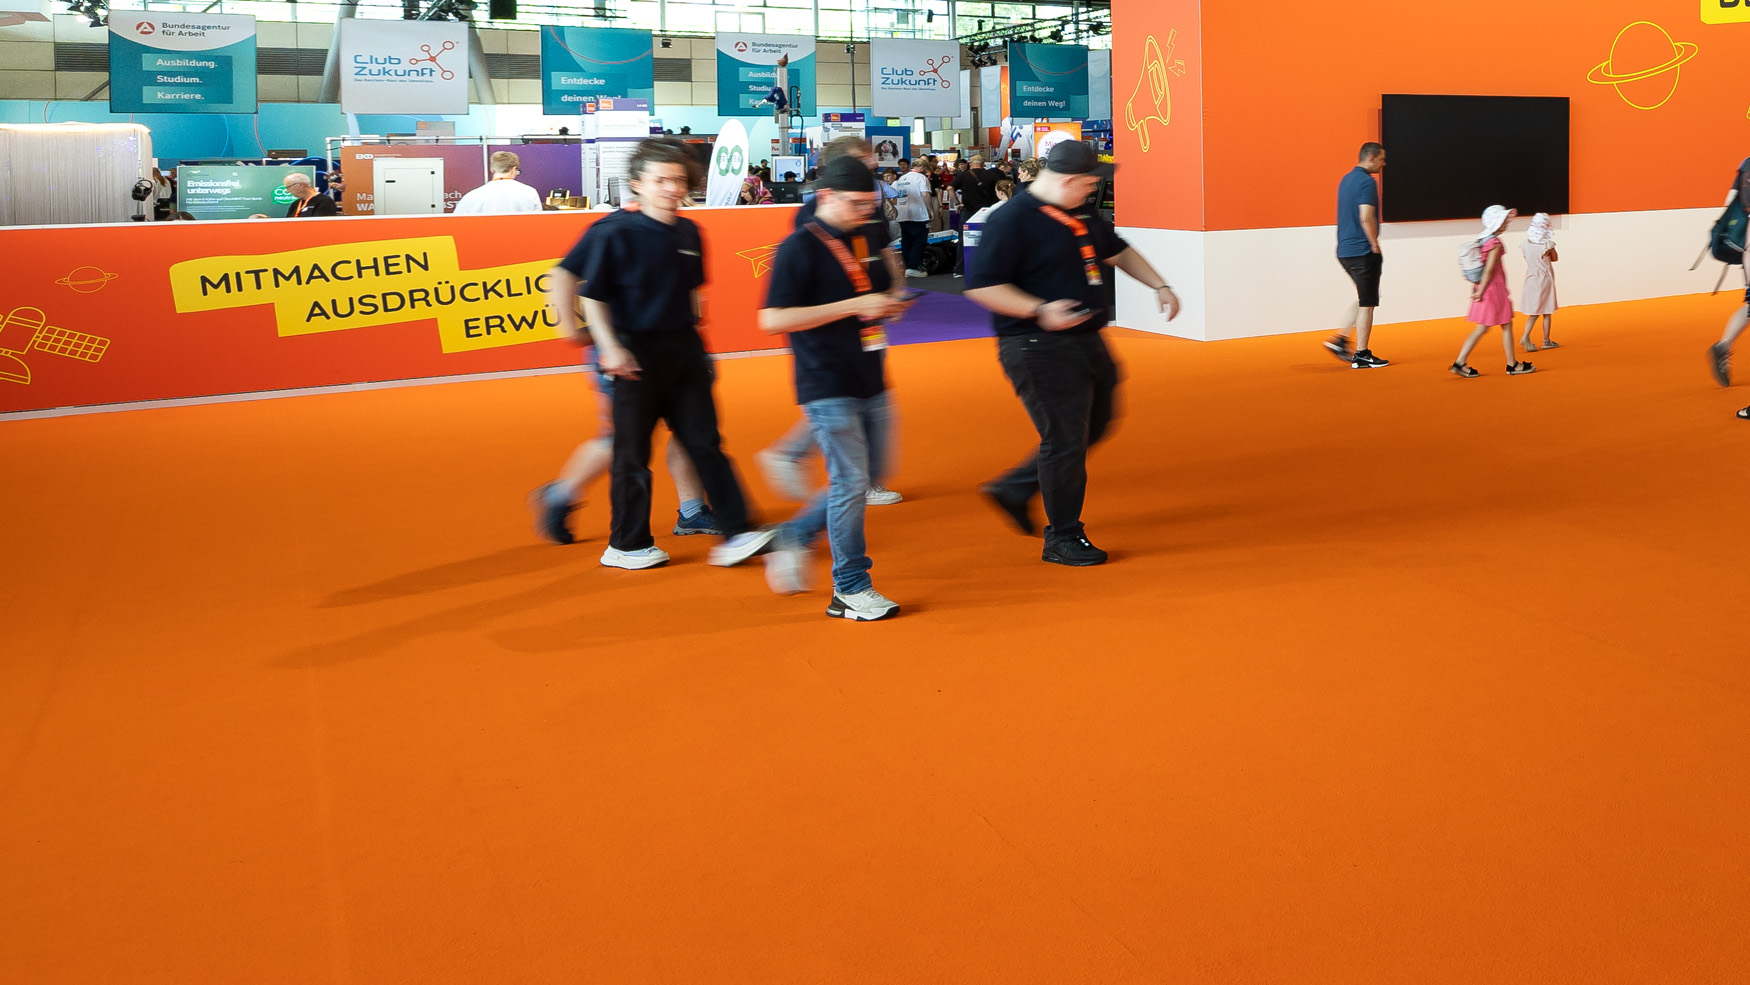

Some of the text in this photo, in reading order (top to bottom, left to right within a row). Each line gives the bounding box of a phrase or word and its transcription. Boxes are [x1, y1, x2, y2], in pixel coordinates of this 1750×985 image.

[161, 22, 232, 31] Bundesagentur
[751, 41, 799, 49] Bundesagentur
[156, 58, 218, 69] Ausbildung.
[353, 55, 402, 65] Club
[353, 66, 436, 77] Zukunft
[881, 67, 914, 76] Club
[156, 75, 203, 84] Studium.
[561, 76, 606, 86] Entdecke
[881, 77, 938, 86] Zukunft
[1022, 85, 1055, 93] Entdecke
[157, 92, 205, 100] Karriere.
[561, 94, 594, 102] deinen
[1048, 100, 1066, 109] Weg!
[199, 252, 430, 297] MITMACHEN
[304, 273, 554, 323] AUSDRÜCKLIC
[463, 303, 587, 339] ERWÜ
